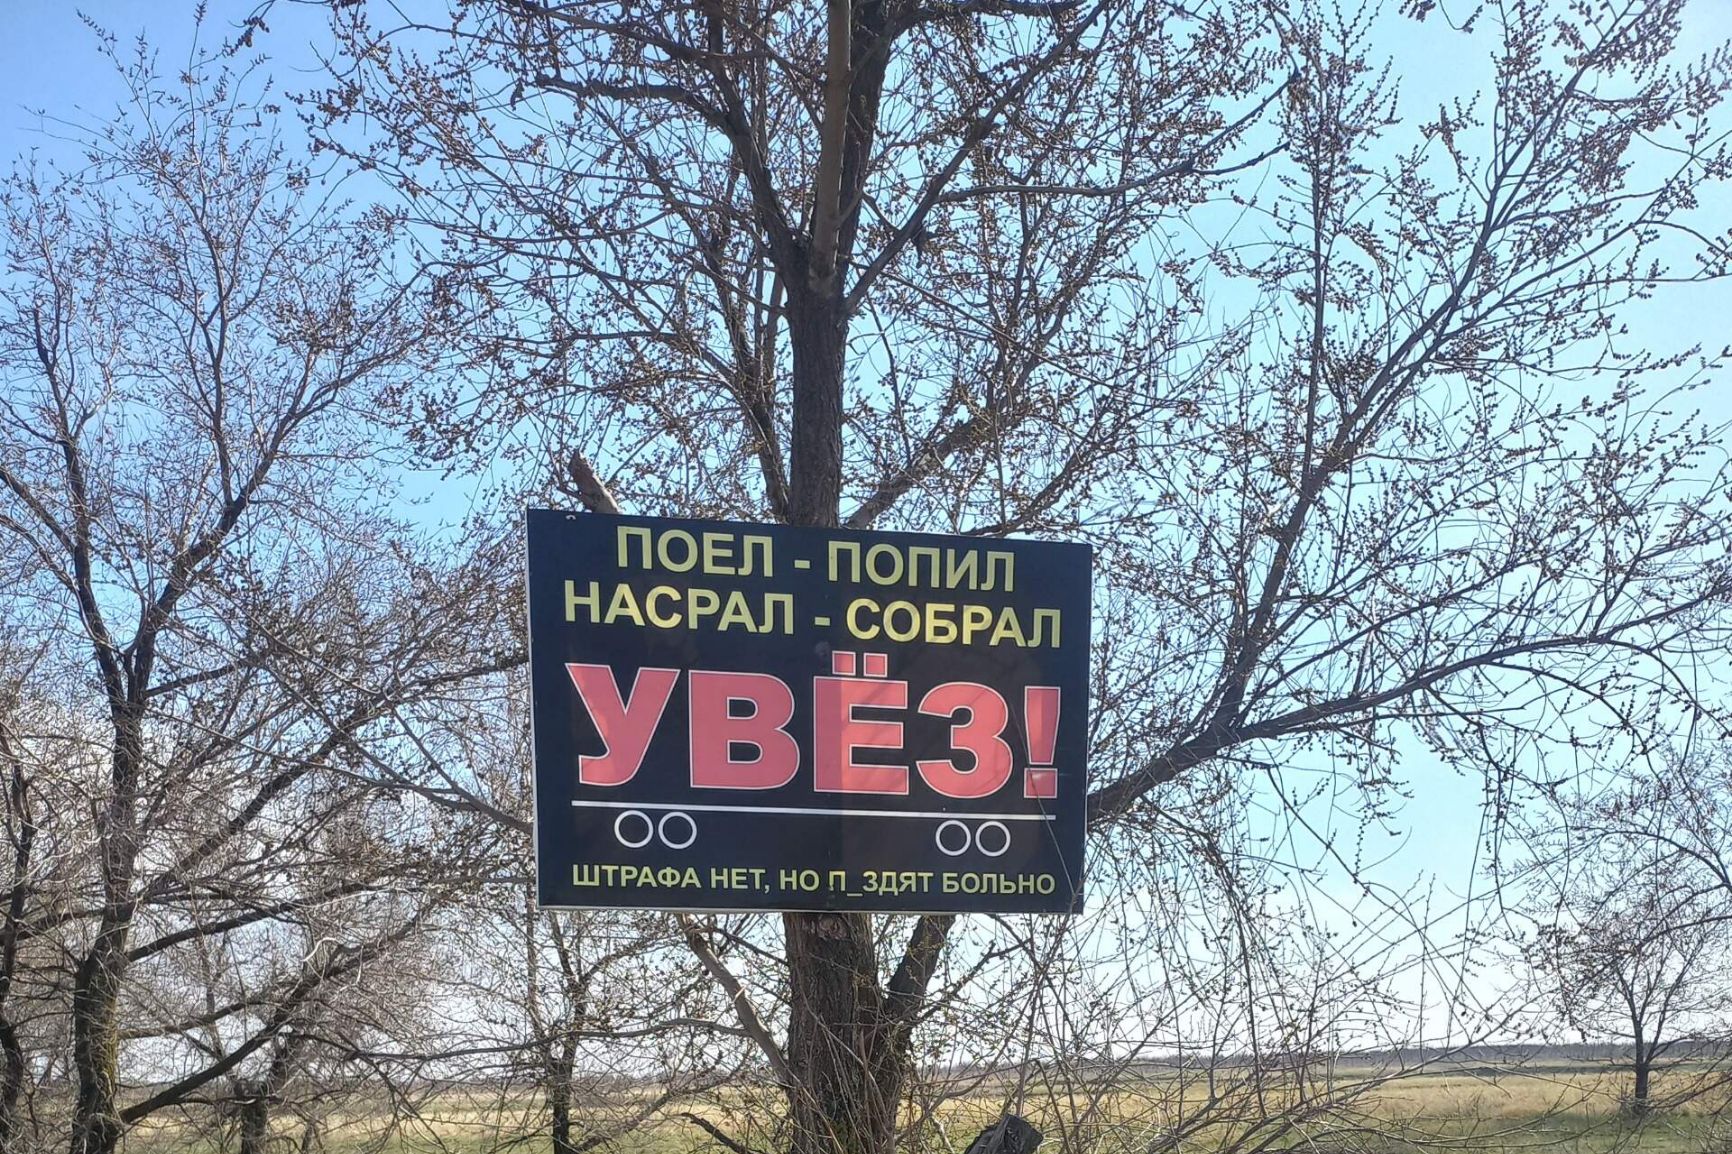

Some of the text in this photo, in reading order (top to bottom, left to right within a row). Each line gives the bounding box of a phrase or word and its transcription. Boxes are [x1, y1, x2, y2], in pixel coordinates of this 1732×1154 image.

[616, 525, 774, 579] ПОЕЛ
[828, 540, 1015, 592] ПОПИЛ
[564, 580, 795, 635] НАСРАЛ
[846, 597, 1062, 649] СОБРАЛ
[564, 650, 1061, 799] УВЁЗ!
[571, 863, 702, 890] ШТРАФА
[710, 866, 770, 893] НЕТ,
[779, 869, 820, 892] НО
[942, 872, 1056, 894] БОЛЬНО
